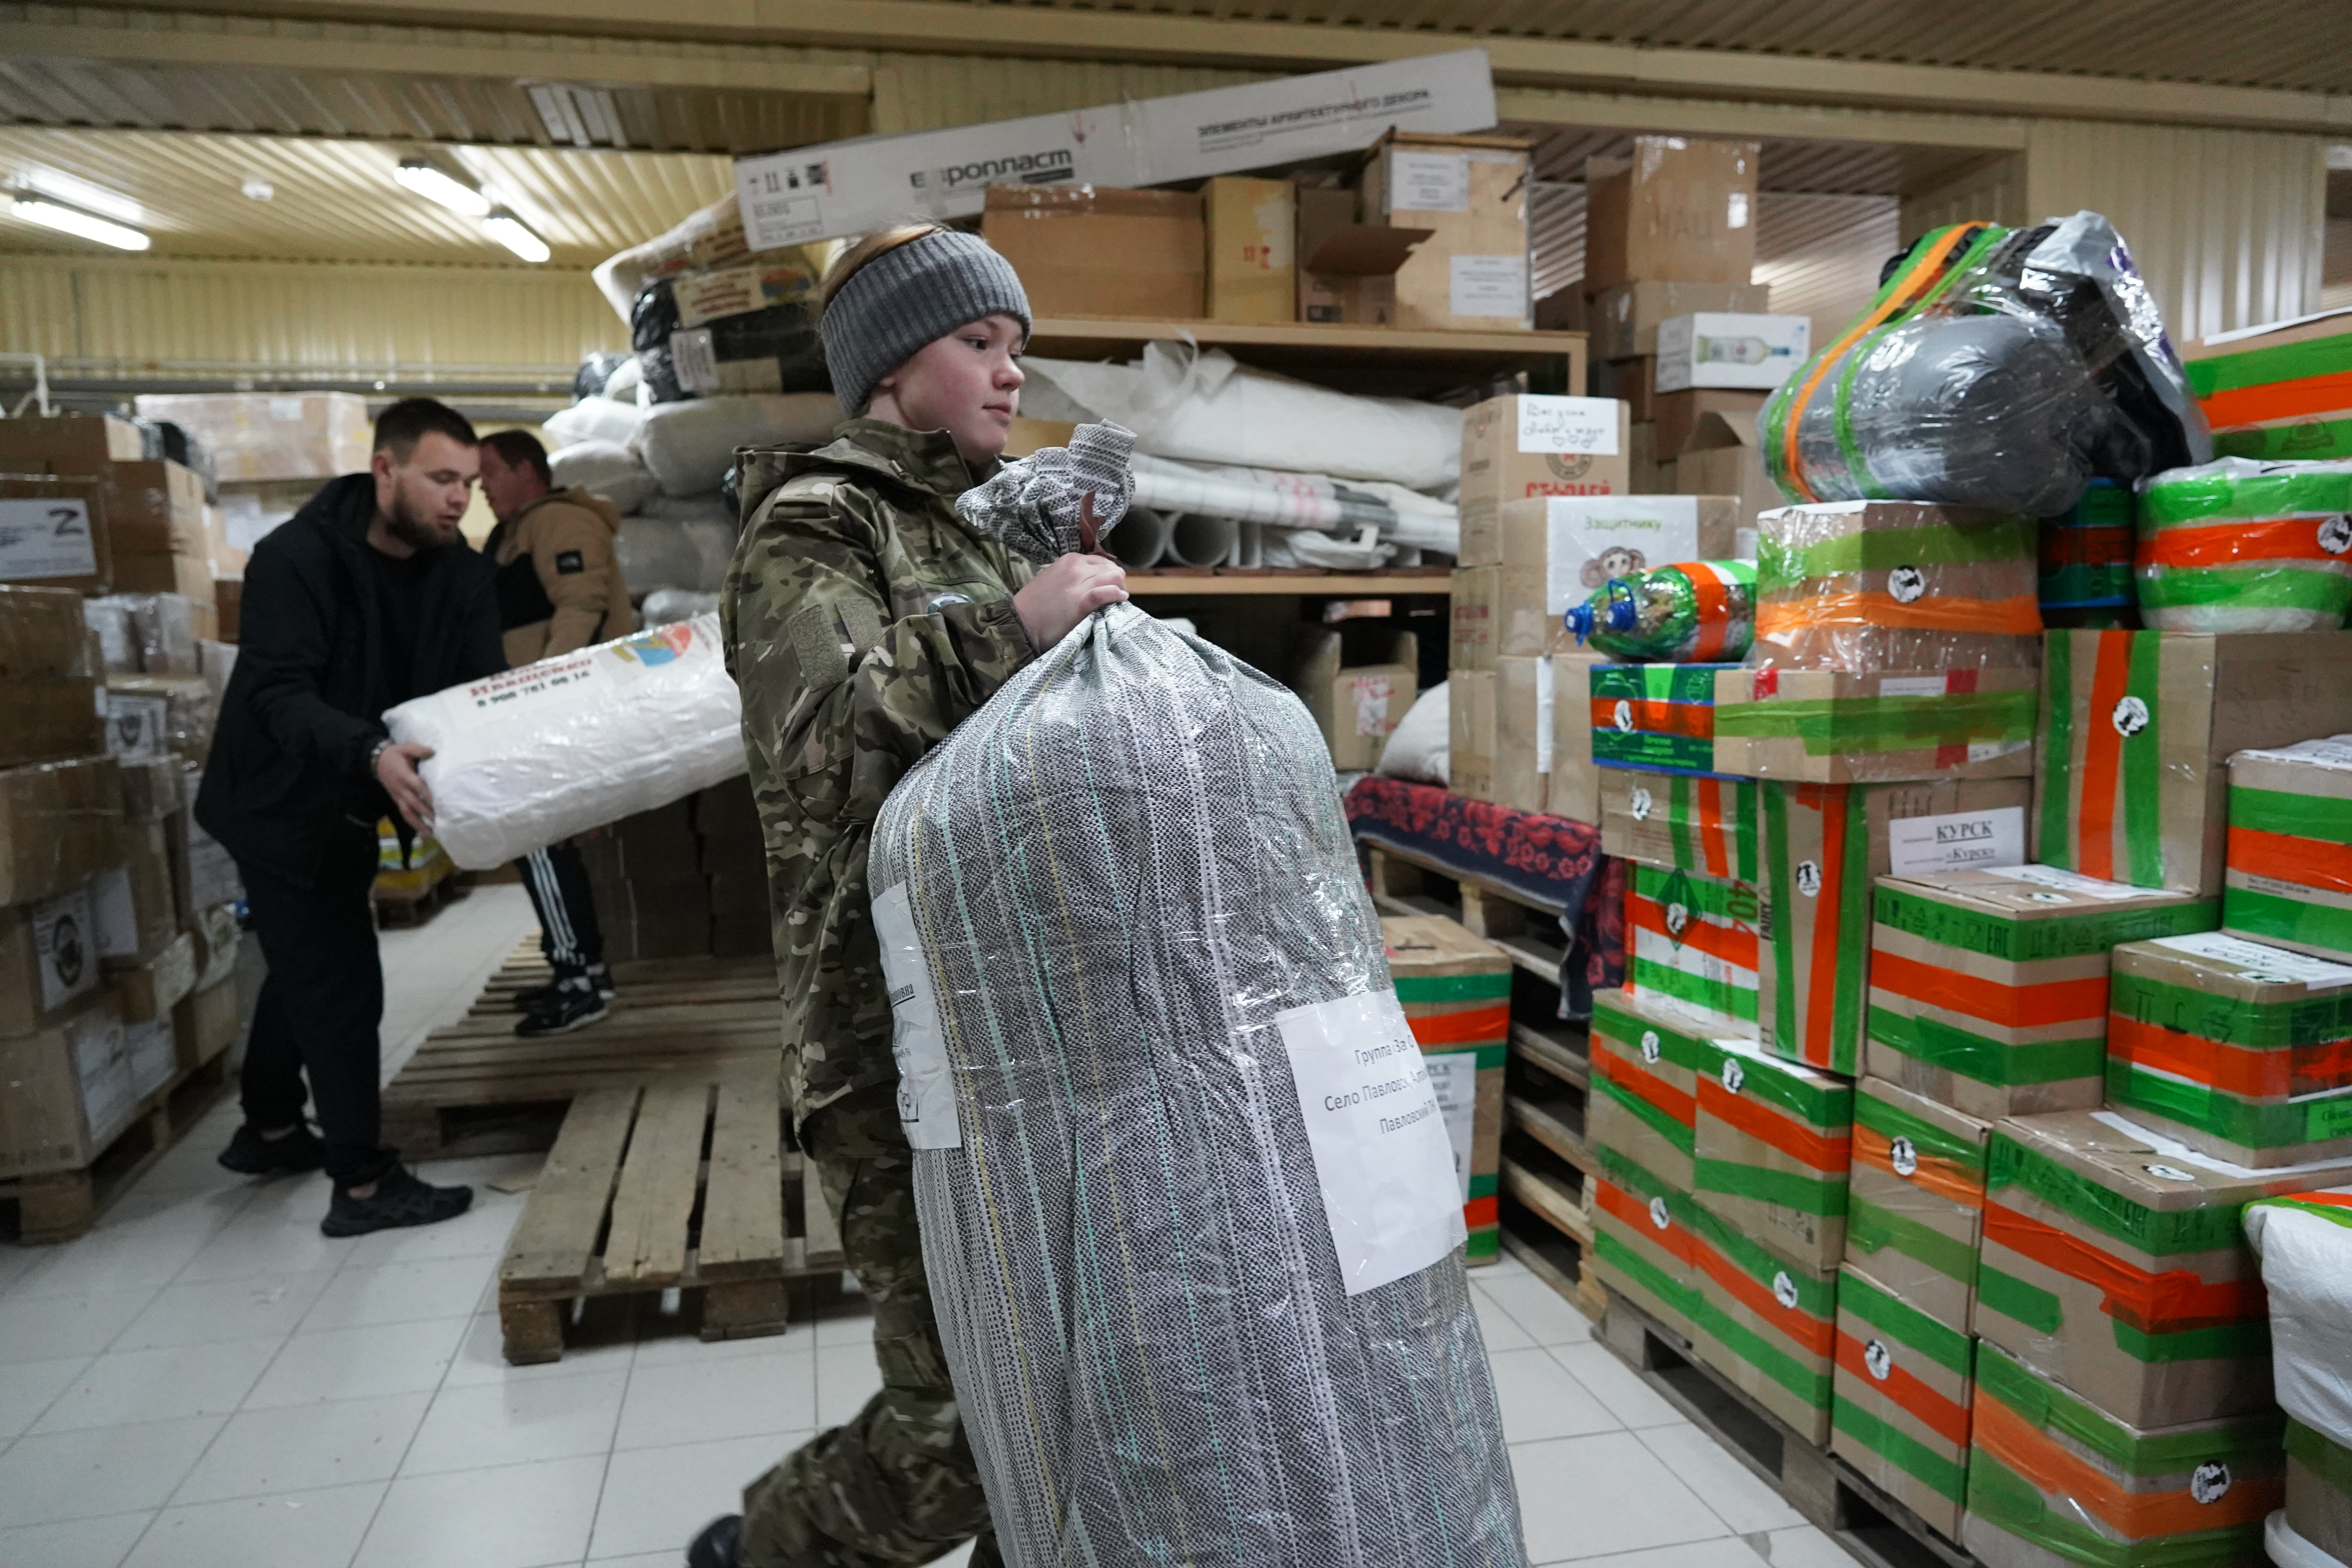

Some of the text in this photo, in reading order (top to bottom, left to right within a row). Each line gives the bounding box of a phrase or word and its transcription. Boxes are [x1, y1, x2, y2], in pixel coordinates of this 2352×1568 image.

[1198, 114, 1268, 137] ЭЛЕМЕНТЫ
[1585, 515, 1663, 532] Защитнику
[1936, 820, 1993, 839] КУРСК
[1355, 1045, 1392, 1066] Группа
[1325, 1092, 1360, 1111] Село
